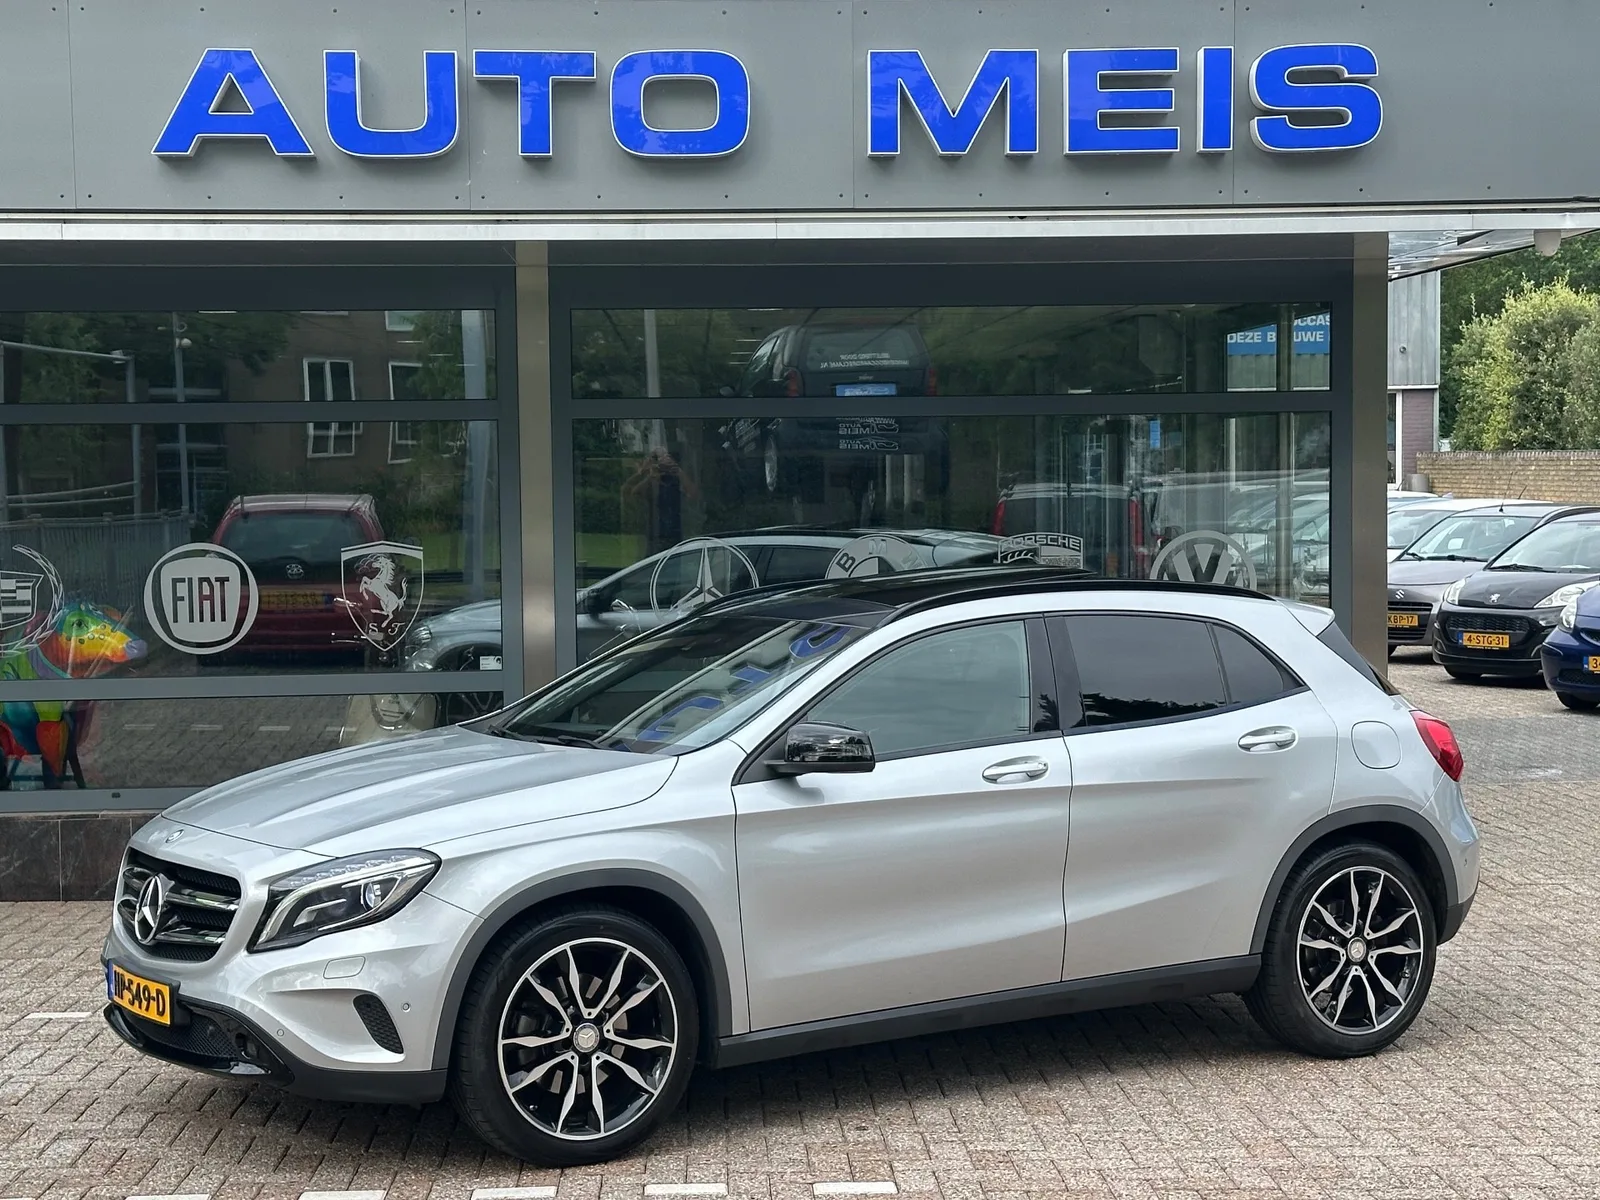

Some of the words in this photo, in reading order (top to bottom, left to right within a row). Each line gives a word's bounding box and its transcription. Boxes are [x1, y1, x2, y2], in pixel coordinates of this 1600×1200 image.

[151, 47, 752, 160] AUTO
[866, 42, 1384, 157] MEIS
[1227, 331, 1262, 343] DEZE
[1267, 331, 1324, 343] BUWE
[1001, 535, 1081, 552] PORSCHE
[171, 576, 230, 624] FIAT
[1466, 634, 1505, 646] 4-STG-31
